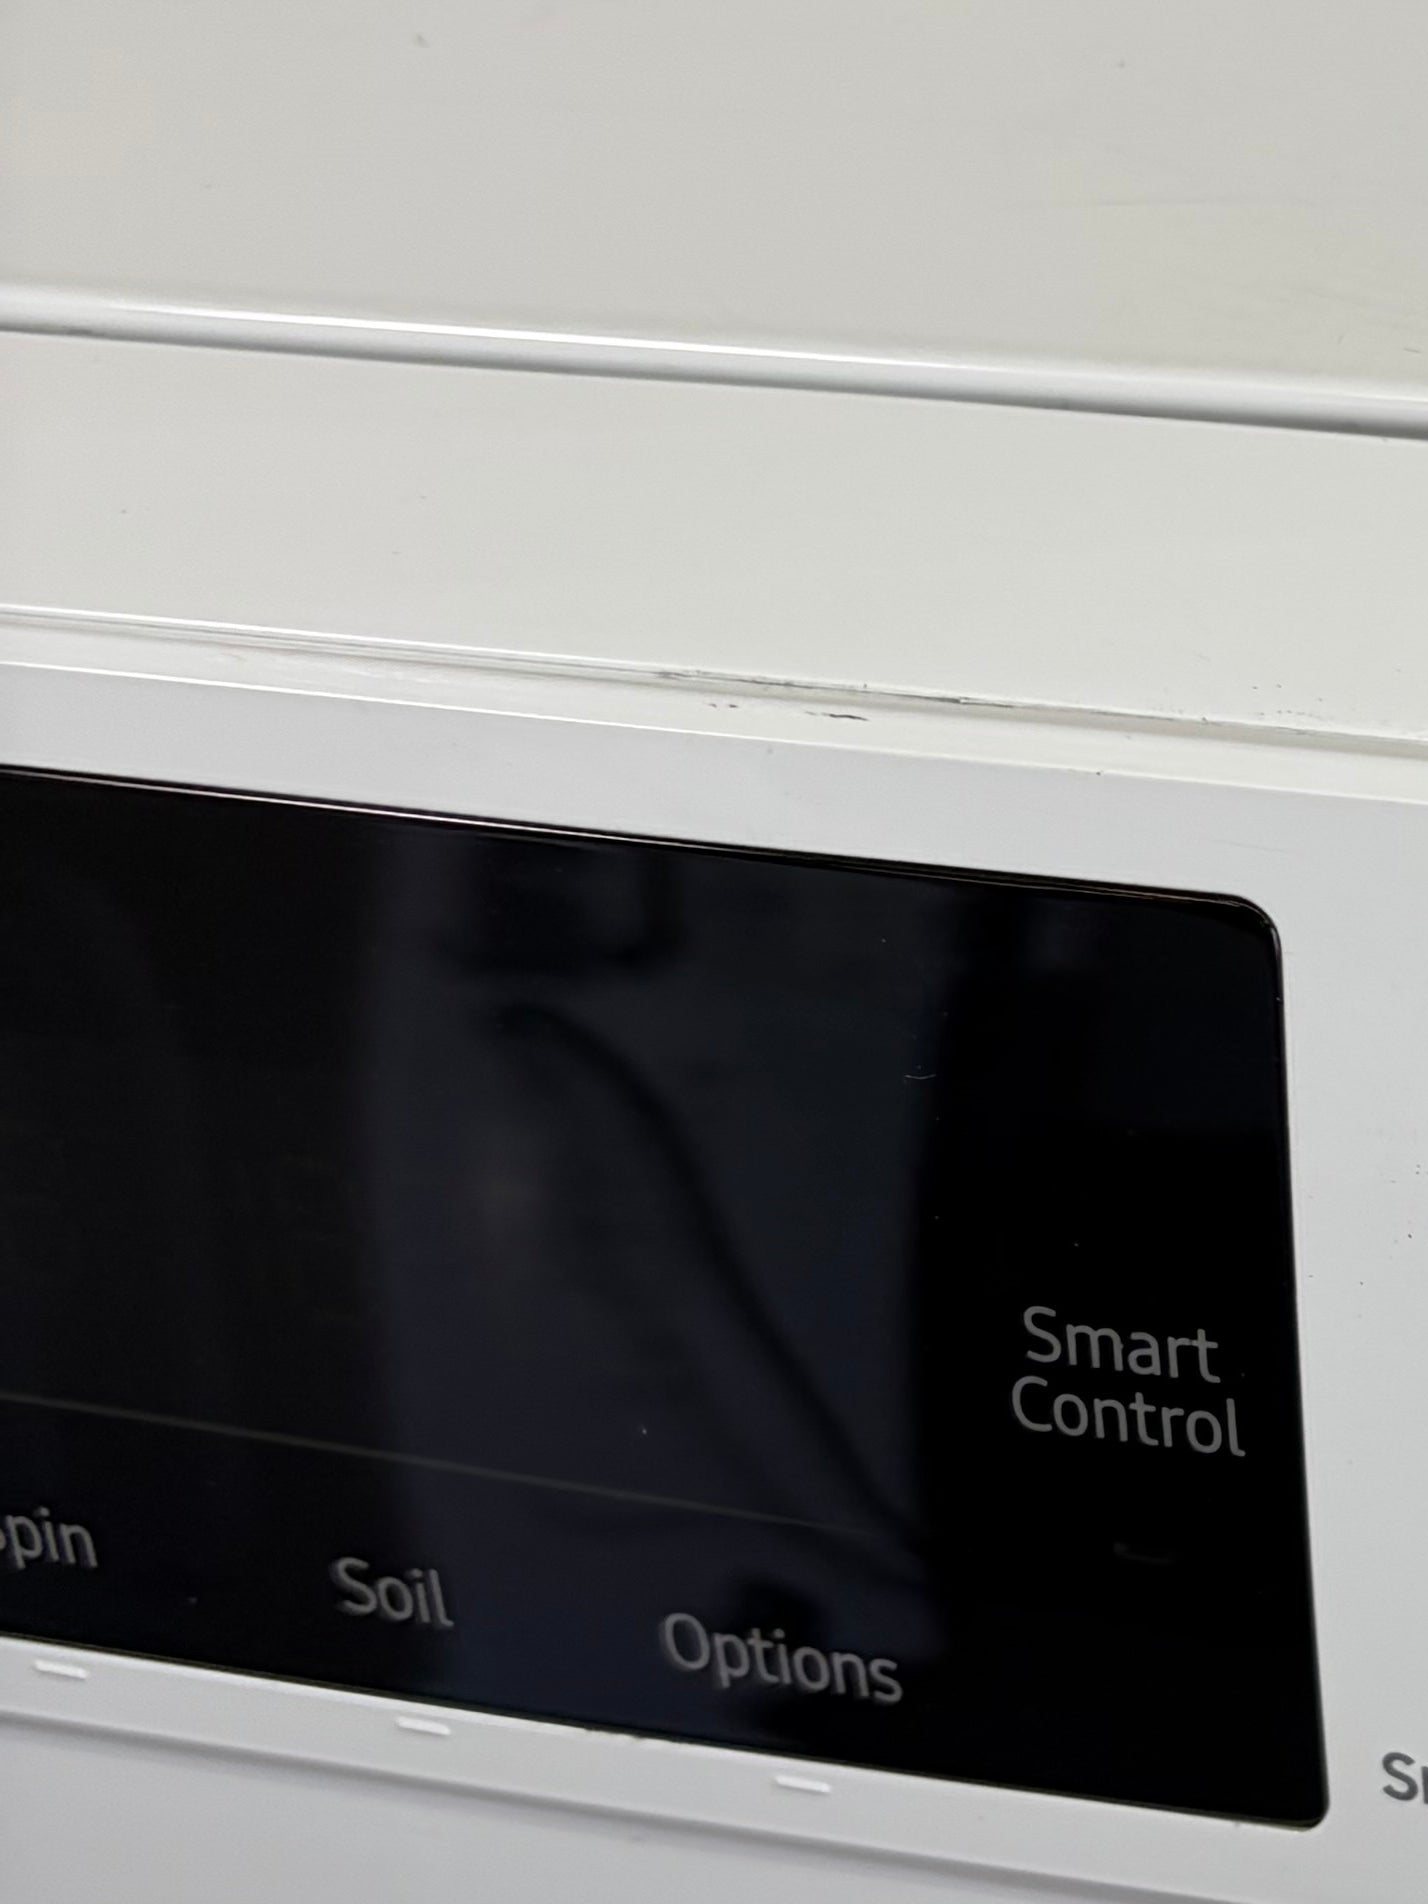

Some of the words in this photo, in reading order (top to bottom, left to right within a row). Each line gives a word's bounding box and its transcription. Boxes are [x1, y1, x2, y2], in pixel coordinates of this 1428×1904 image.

[1023, 1305, 1221, 1384] Smart
[1011, 1375, 1246, 1457] Control
[0, 1506, 98, 1570] pin
[330, 1555, 454, 1628] Soil
[658, 1612, 903, 1704] Options
